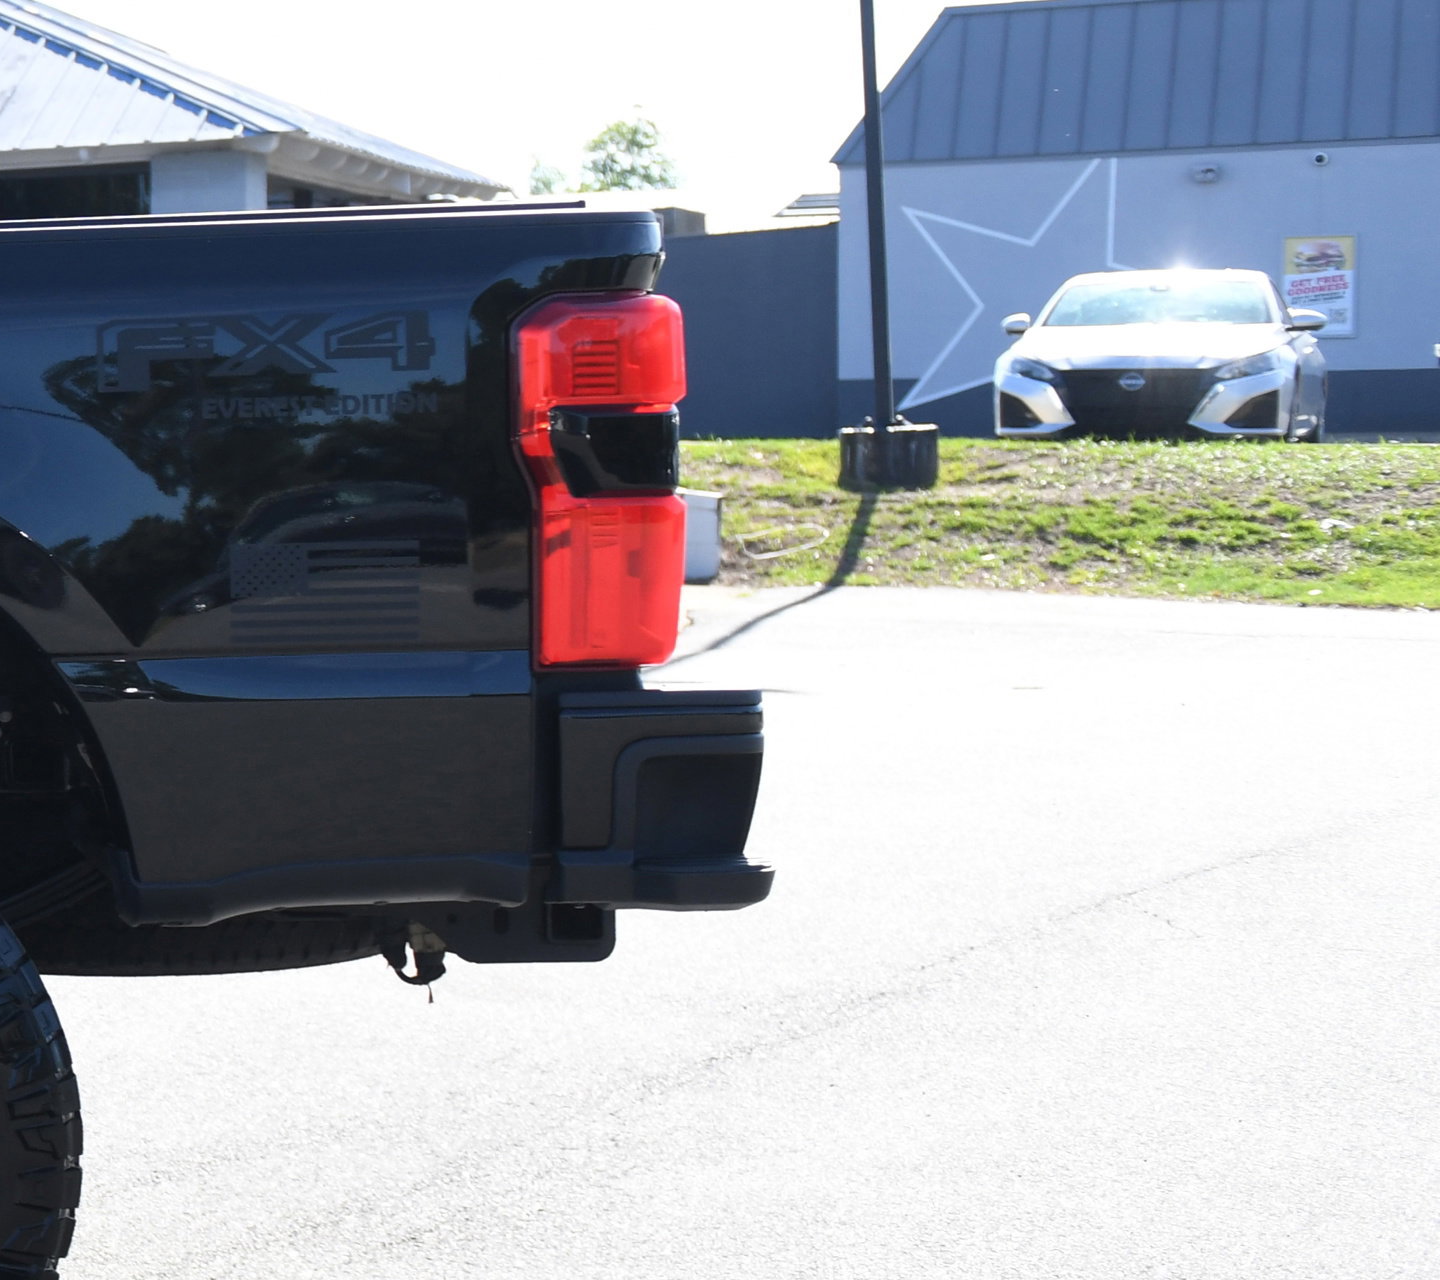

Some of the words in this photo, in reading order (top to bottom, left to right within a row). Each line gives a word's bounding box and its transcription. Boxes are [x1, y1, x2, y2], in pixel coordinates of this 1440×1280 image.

[96, 309, 436, 394] FX4
[201, 395, 314, 420] EVEREST
[324, 391, 438, 417] EDITION
